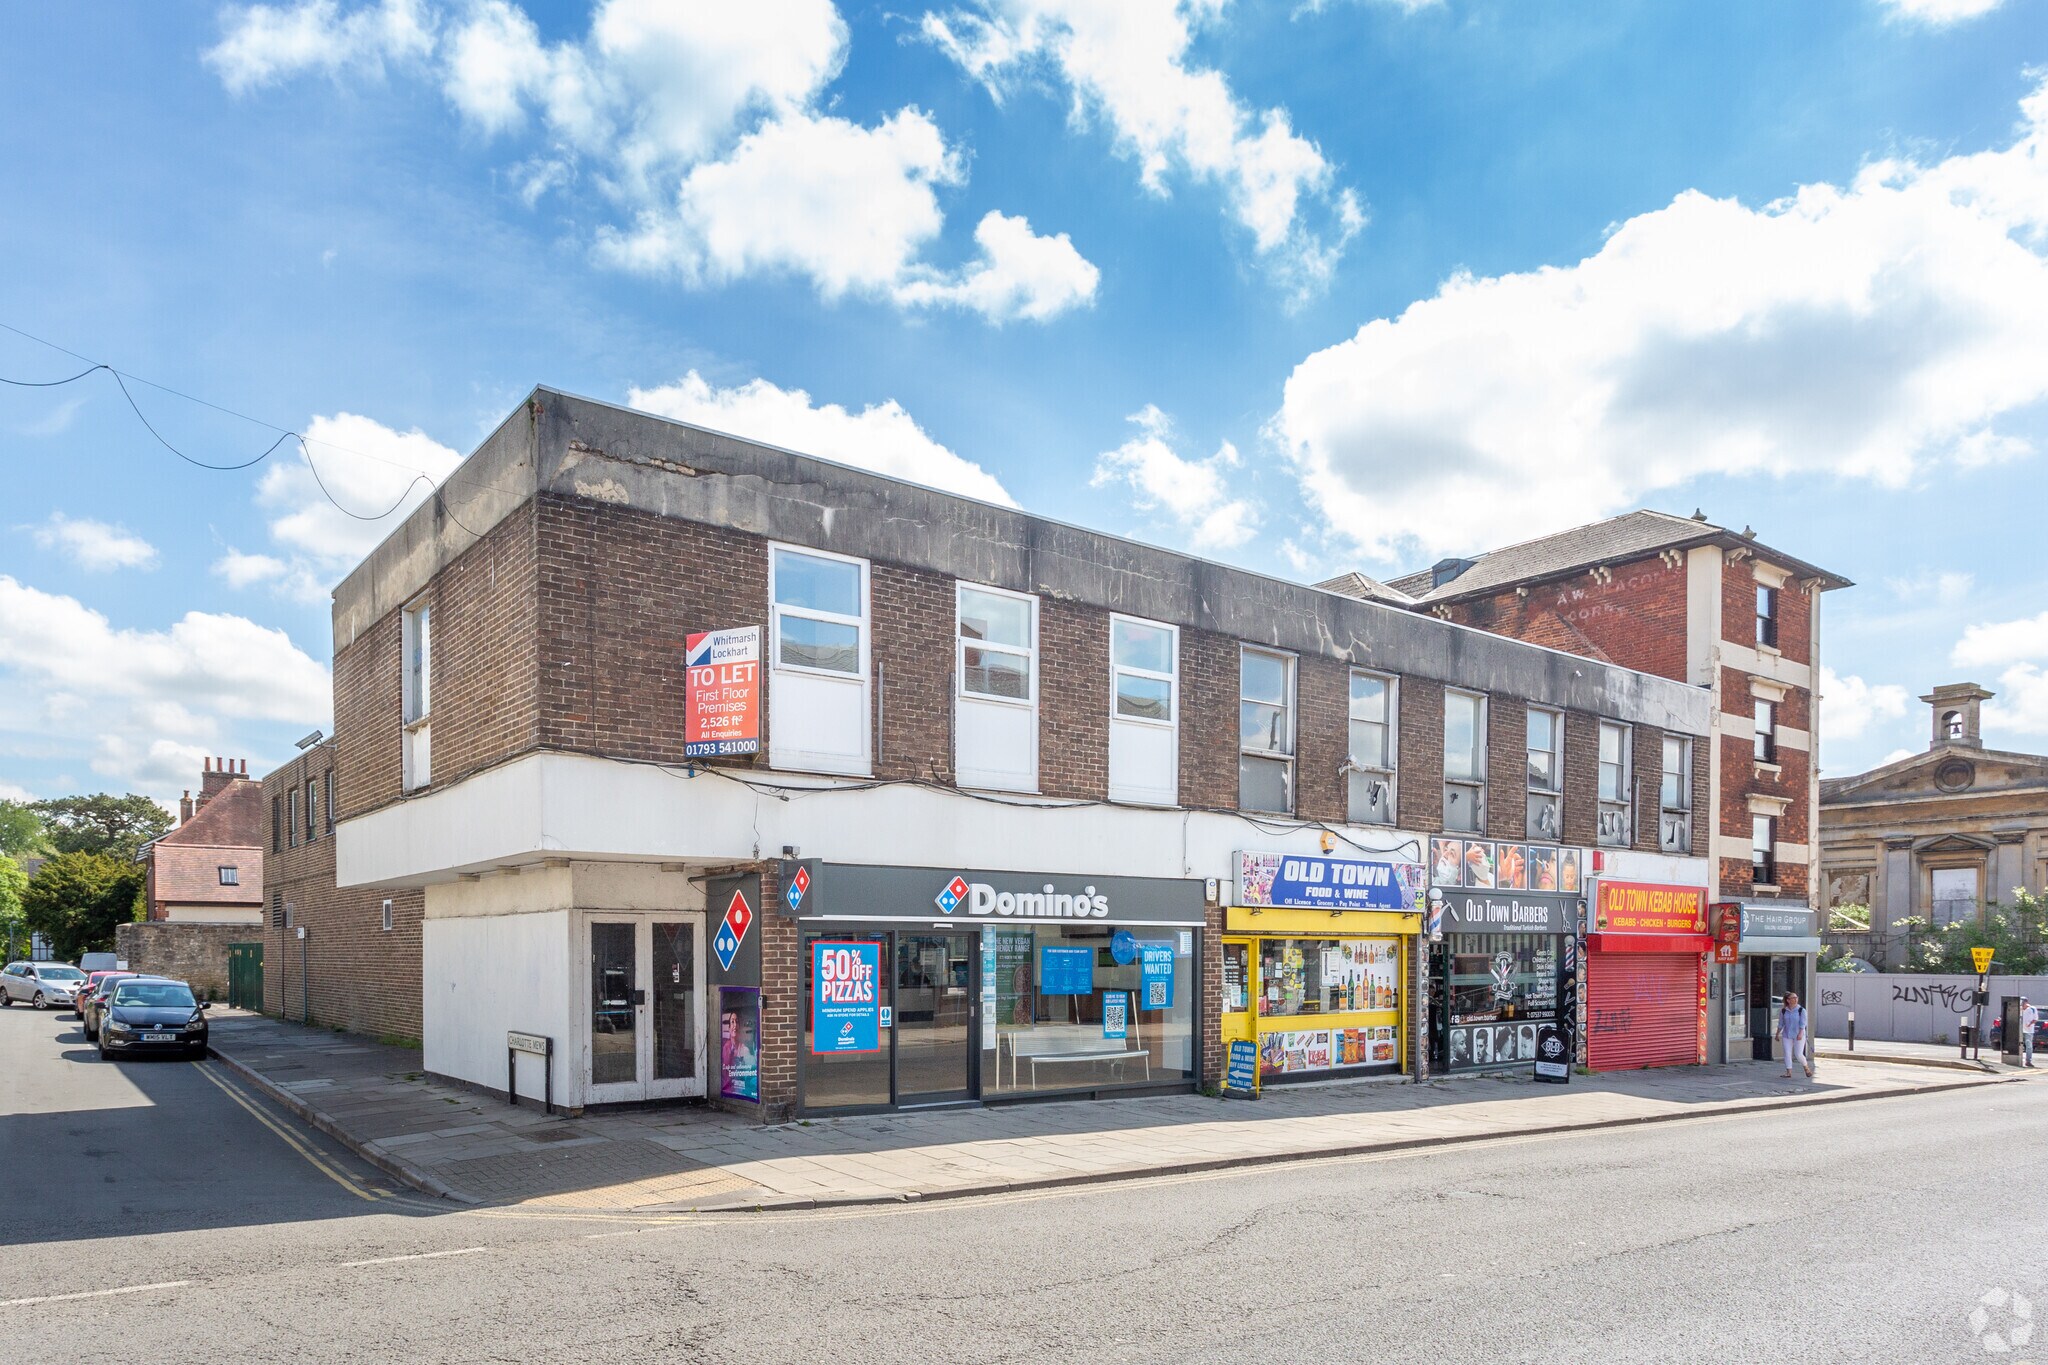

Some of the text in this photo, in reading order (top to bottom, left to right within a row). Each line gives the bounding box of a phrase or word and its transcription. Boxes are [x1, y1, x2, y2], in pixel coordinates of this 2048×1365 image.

[714, 633, 757, 646] Whitmarsh
[713, 646, 748, 658] Lockhart
[690, 663, 756, 687] TO LET
[696, 688, 749, 702] First Floor
[698, 700, 747, 714] Premises
[701, 716, 729, 729] 2,526
[701, 729, 742, 739] All Enquiries
[686, 740, 756, 756] 01793 541000
[1284, 860, 1390, 887] OLD TOWN
[1305, 886, 1369, 900] FOOD & WINE
[968, 883, 1109, 918] Domino's
[1294, 898, 1312, 906] Licence
[1316, 899, 1334, 908] Grocery
[1339, 900, 1347, 908] Pay
[1609, 888, 1697, 914] OLD TOWN KEBAB HOUSE
[1614, 917, 1692, 928] KEBABS CHICKEN BURGERS
[1002, 937, 1014, 945] NEW
[1014, 937, 1031, 945] VEGAN
[1144, 951, 1172, 962] DRIVERS
[852, 964, 873, 981] OFF
[1144, 963, 1172, 974] WANTED
[821, 981, 874, 1003] PIZZAS
[510, 1036, 544, 1051] CHARLOTTE MEWS
[1231, 1053, 1241, 1061] FOOD
